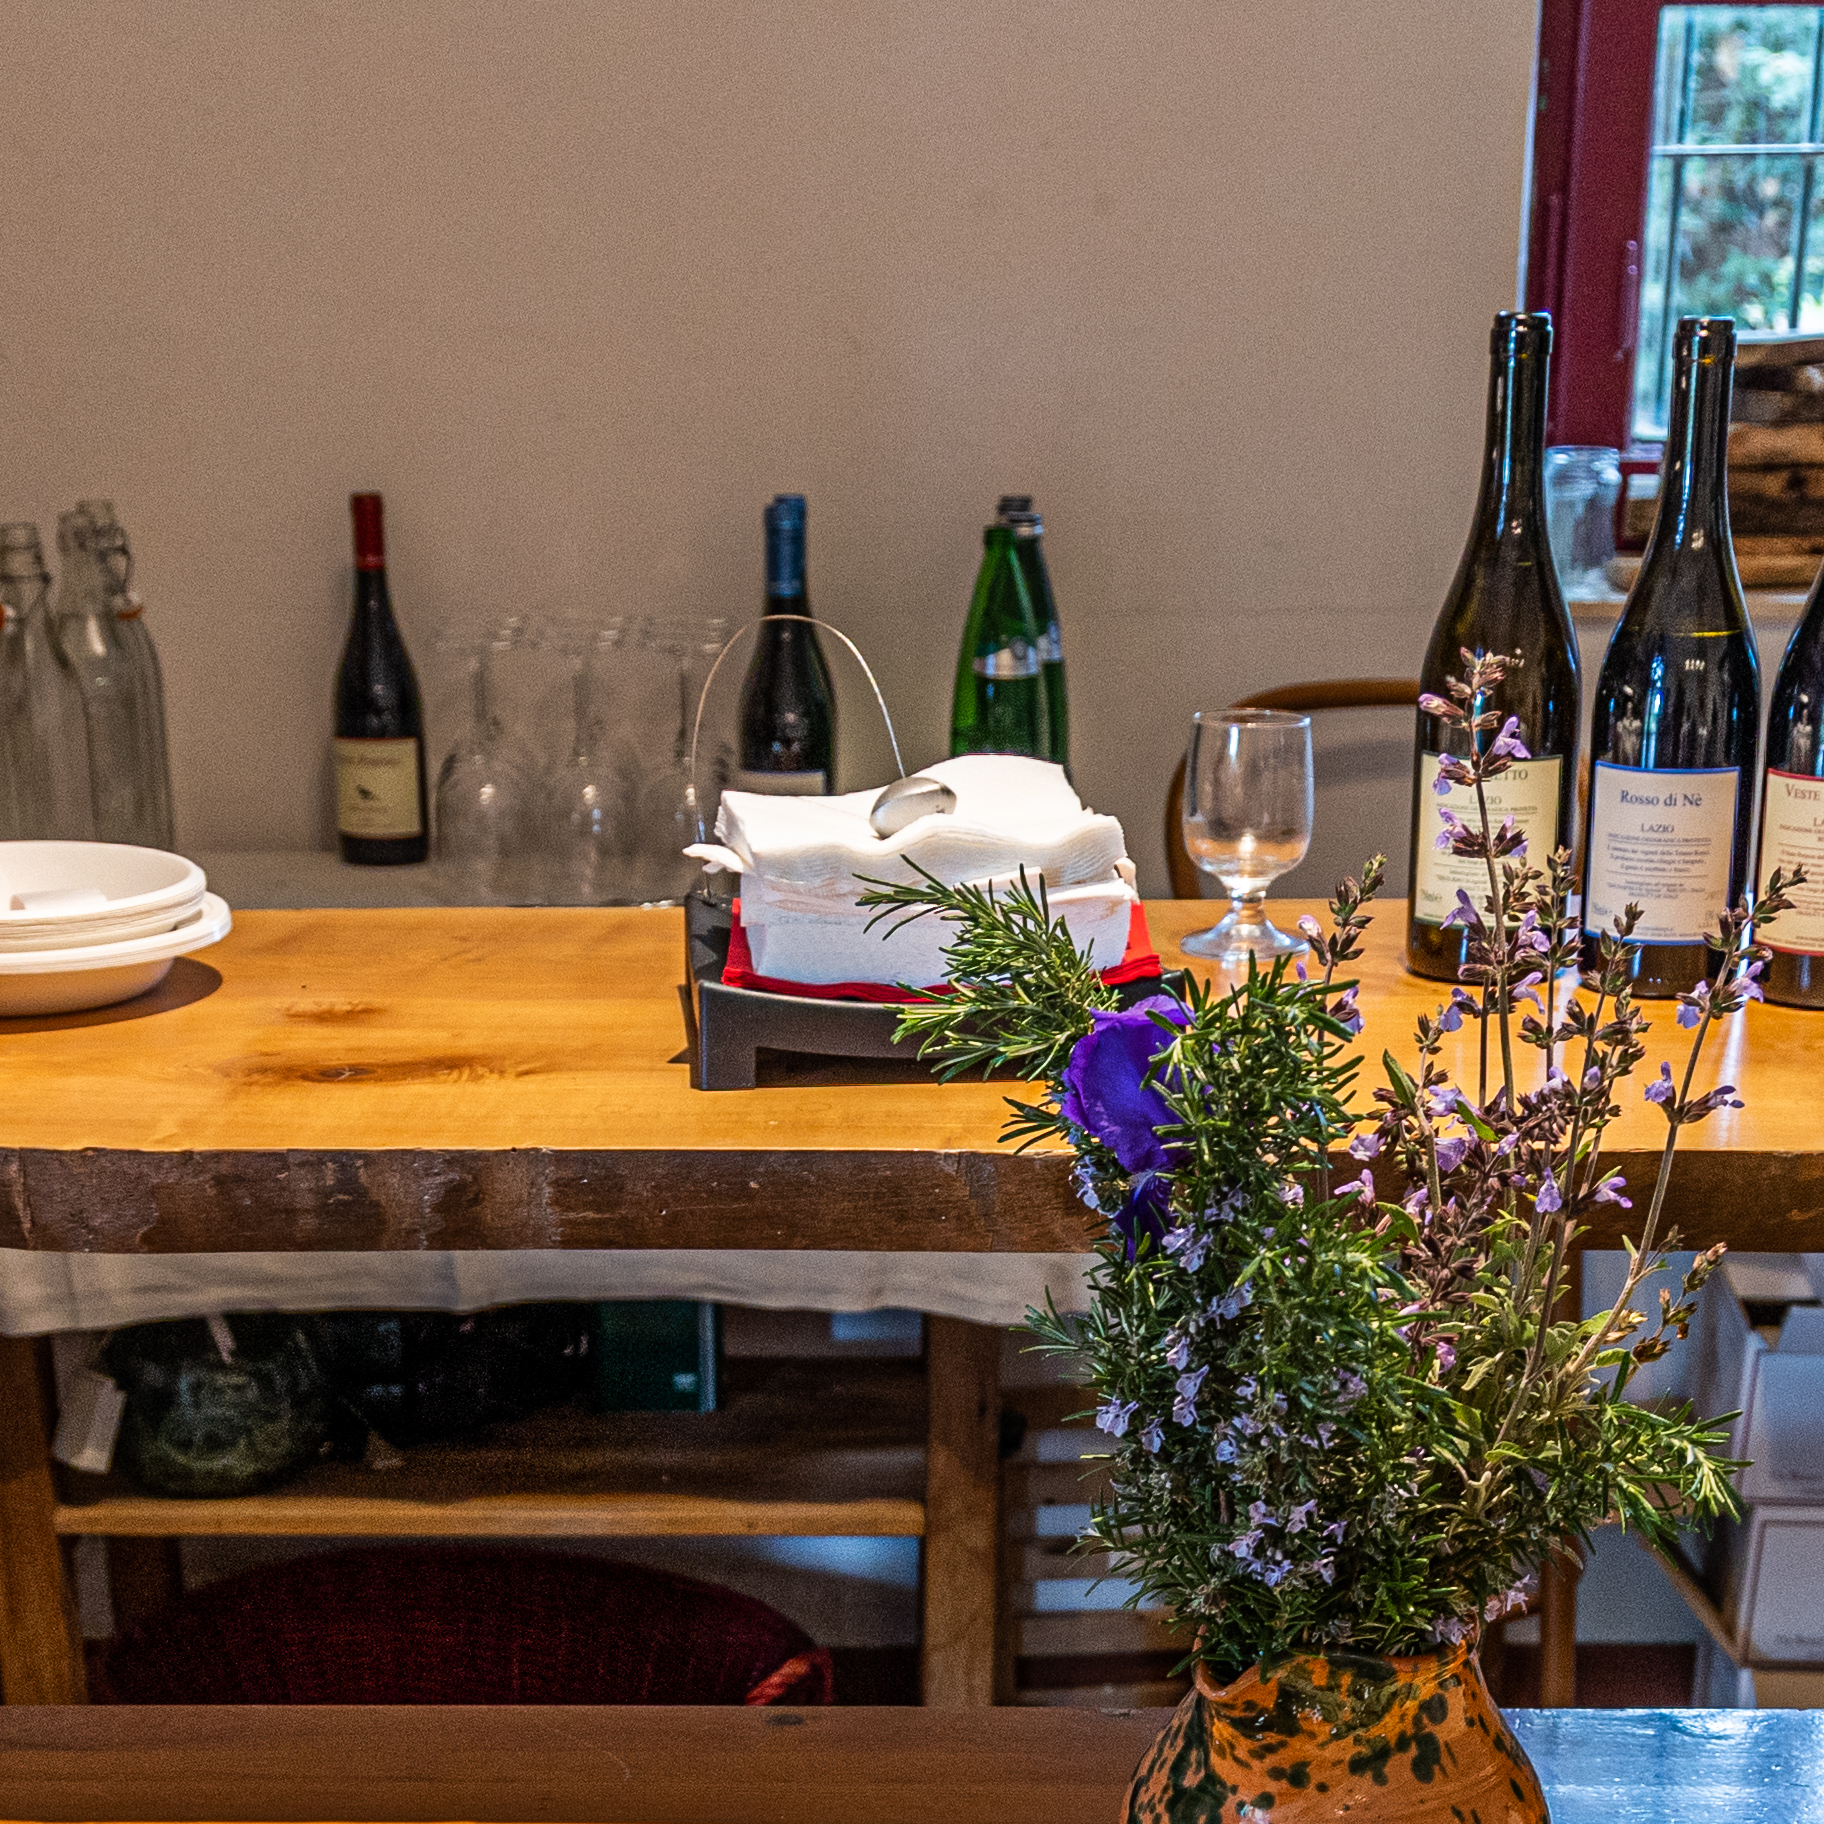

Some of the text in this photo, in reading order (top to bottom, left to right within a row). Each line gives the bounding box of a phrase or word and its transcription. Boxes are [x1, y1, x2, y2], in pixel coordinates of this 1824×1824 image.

[1620, 790, 1702, 807] Rosso di Nè
[1784, 783, 1820, 801] VESTE
[1640, 823, 1675, 833] LAZIO
